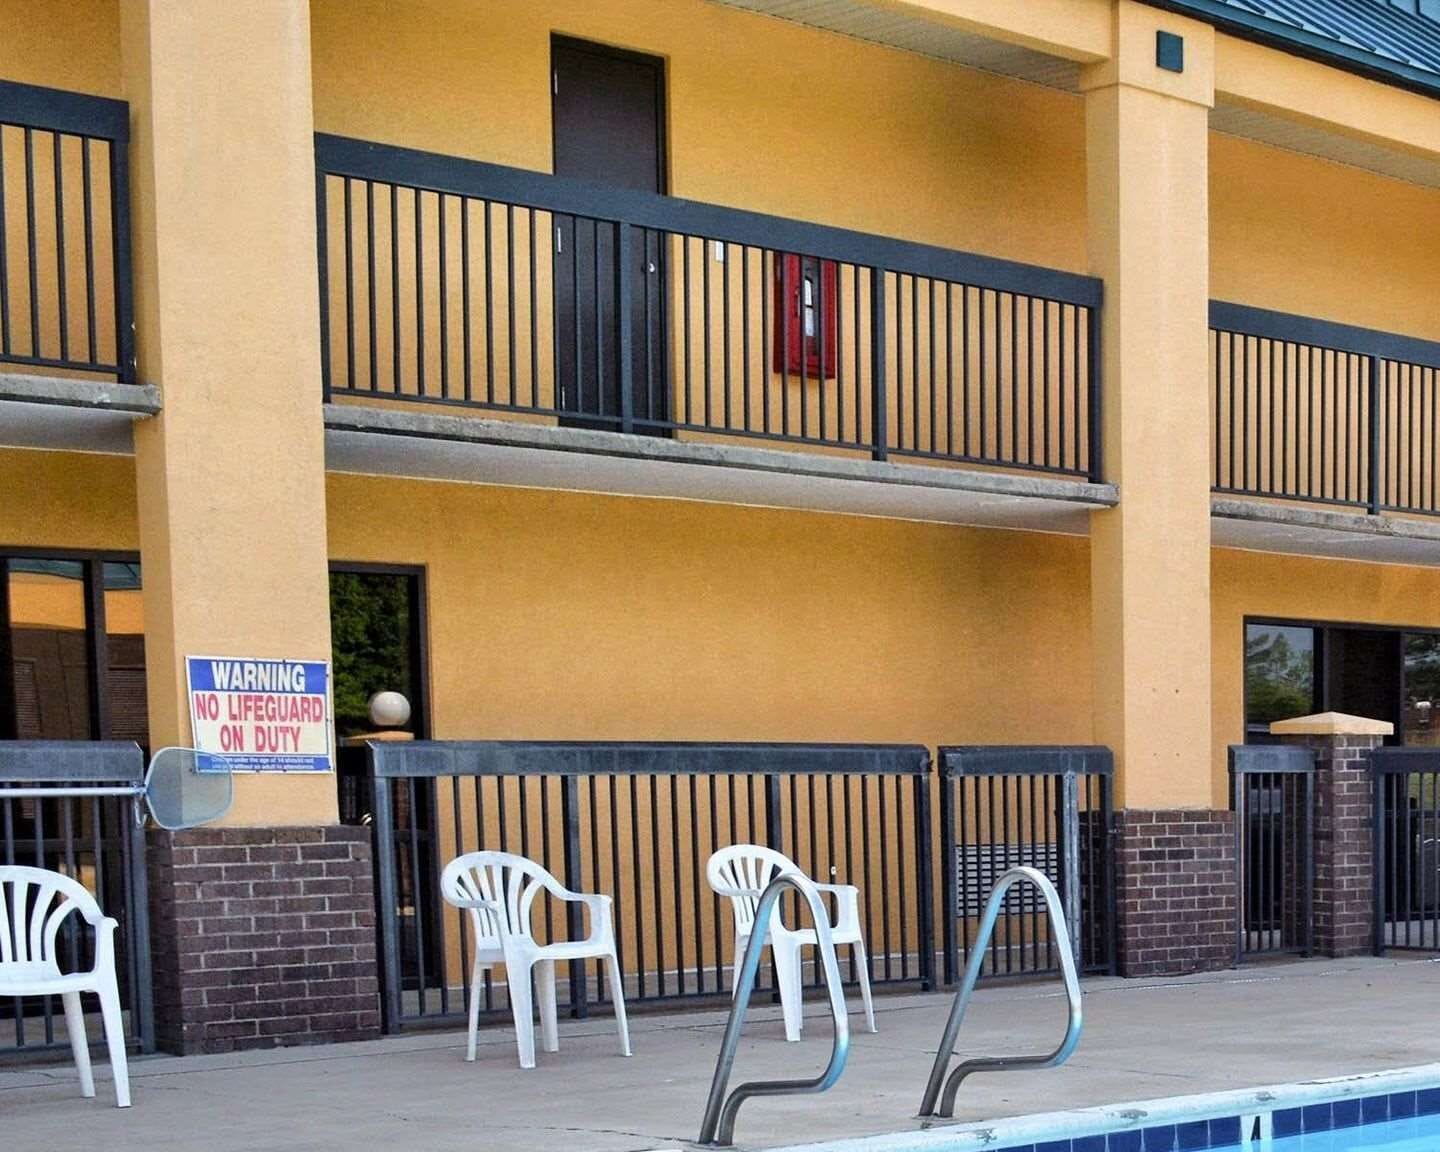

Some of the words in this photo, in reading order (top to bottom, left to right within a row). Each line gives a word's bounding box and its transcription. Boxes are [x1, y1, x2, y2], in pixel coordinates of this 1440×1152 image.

[211, 661, 306, 692] WARNING
[195, 693, 219, 721] NO
[228, 694, 323, 723] LIFEGUARD
[220, 724, 244, 752] ON
[254, 725, 301, 752] DUTY
